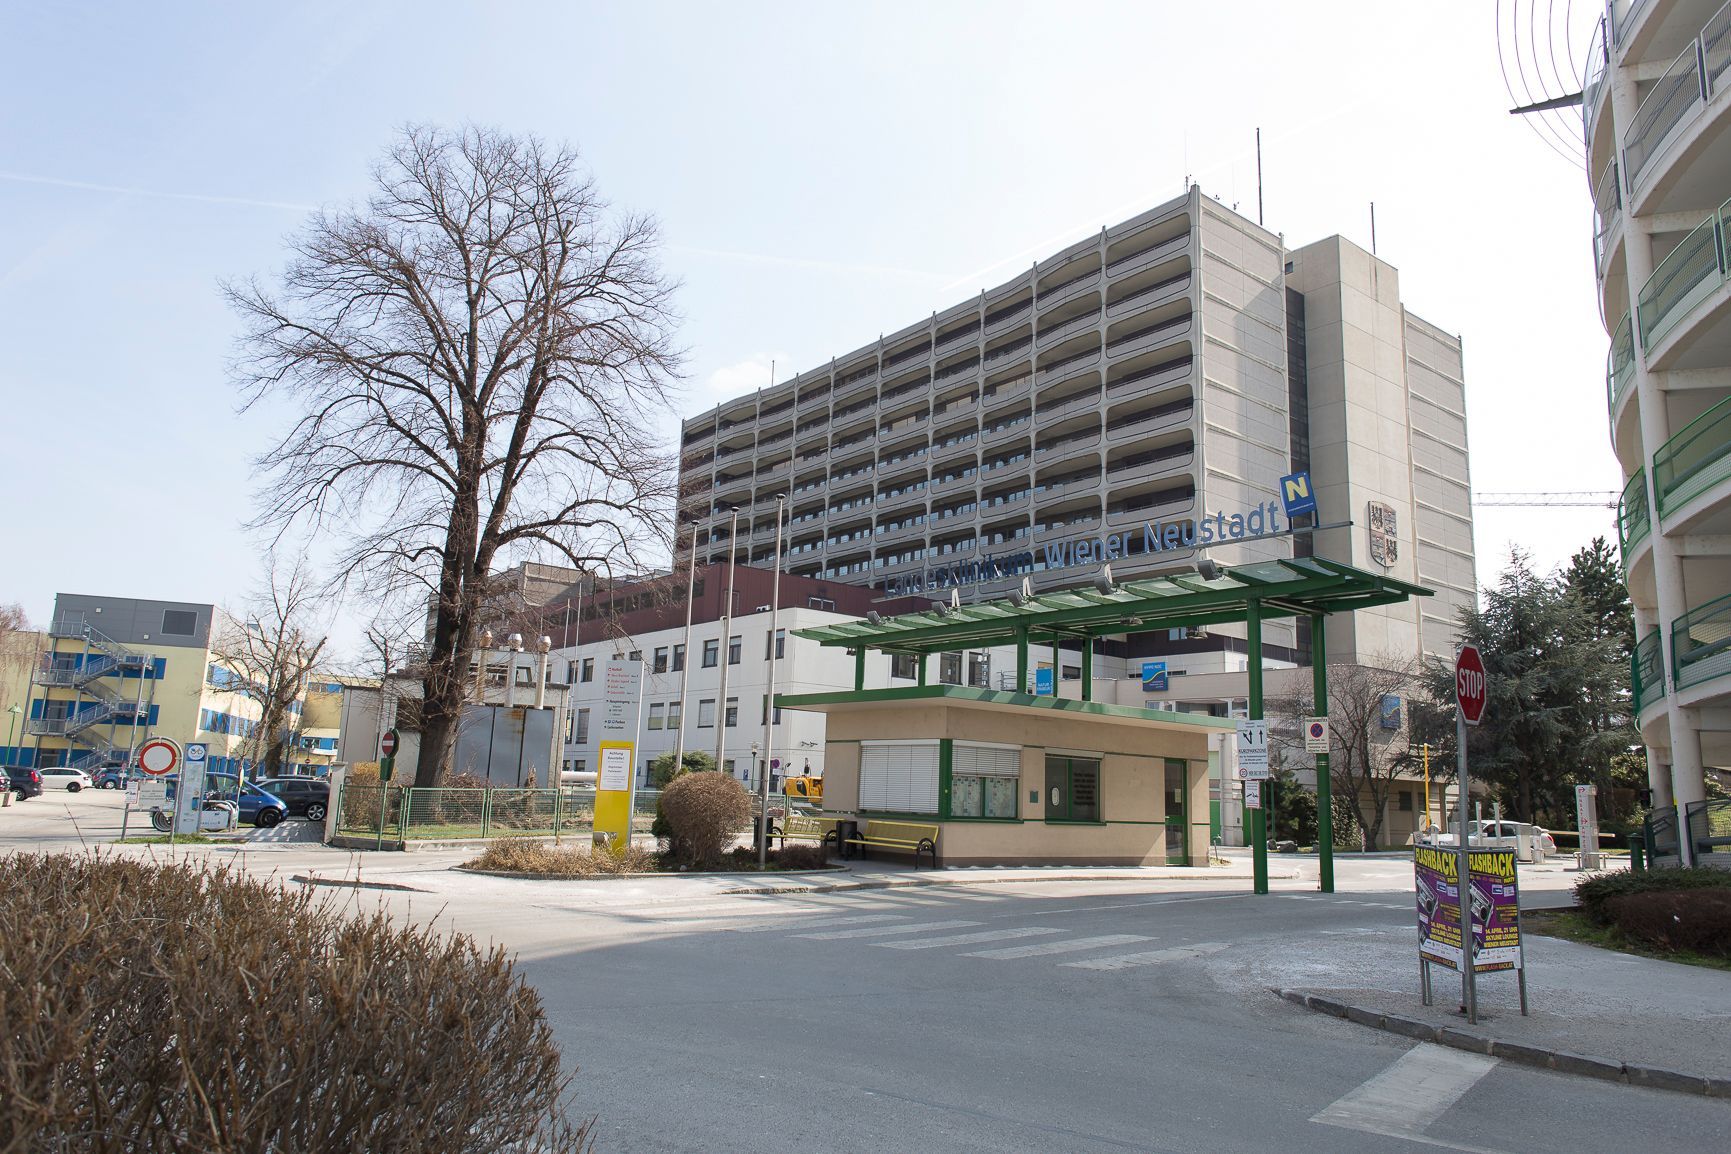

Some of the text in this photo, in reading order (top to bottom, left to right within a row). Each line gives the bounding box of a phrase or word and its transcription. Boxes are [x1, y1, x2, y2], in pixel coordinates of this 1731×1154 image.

[1285, 476, 1309, 502] N
[884, 500, 1280, 599] Landesklinikum Wiener Neustadt
[1459, 667, 1483, 699] STOP
[1415, 847, 1458, 876] FLASHBACK
[1468, 853, 1515, 876] FLASHBACK
[1503, 876, 1515, 884] PARTY
